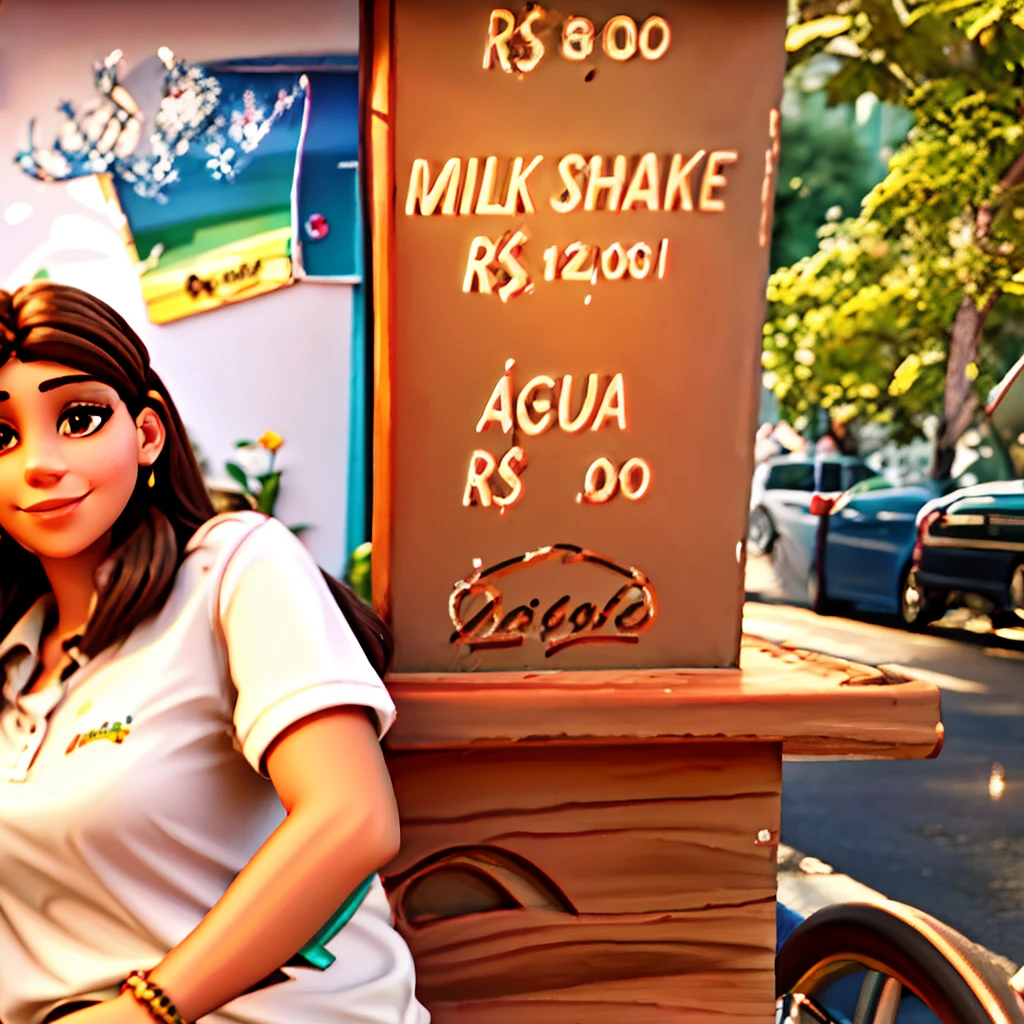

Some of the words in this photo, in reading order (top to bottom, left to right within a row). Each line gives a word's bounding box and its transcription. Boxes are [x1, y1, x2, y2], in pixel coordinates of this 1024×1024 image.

[405, 154, 544, 216] MILK
[550, 150, 738, 214] SHAKE
[475, 357, 626, 436] ÁGUA
